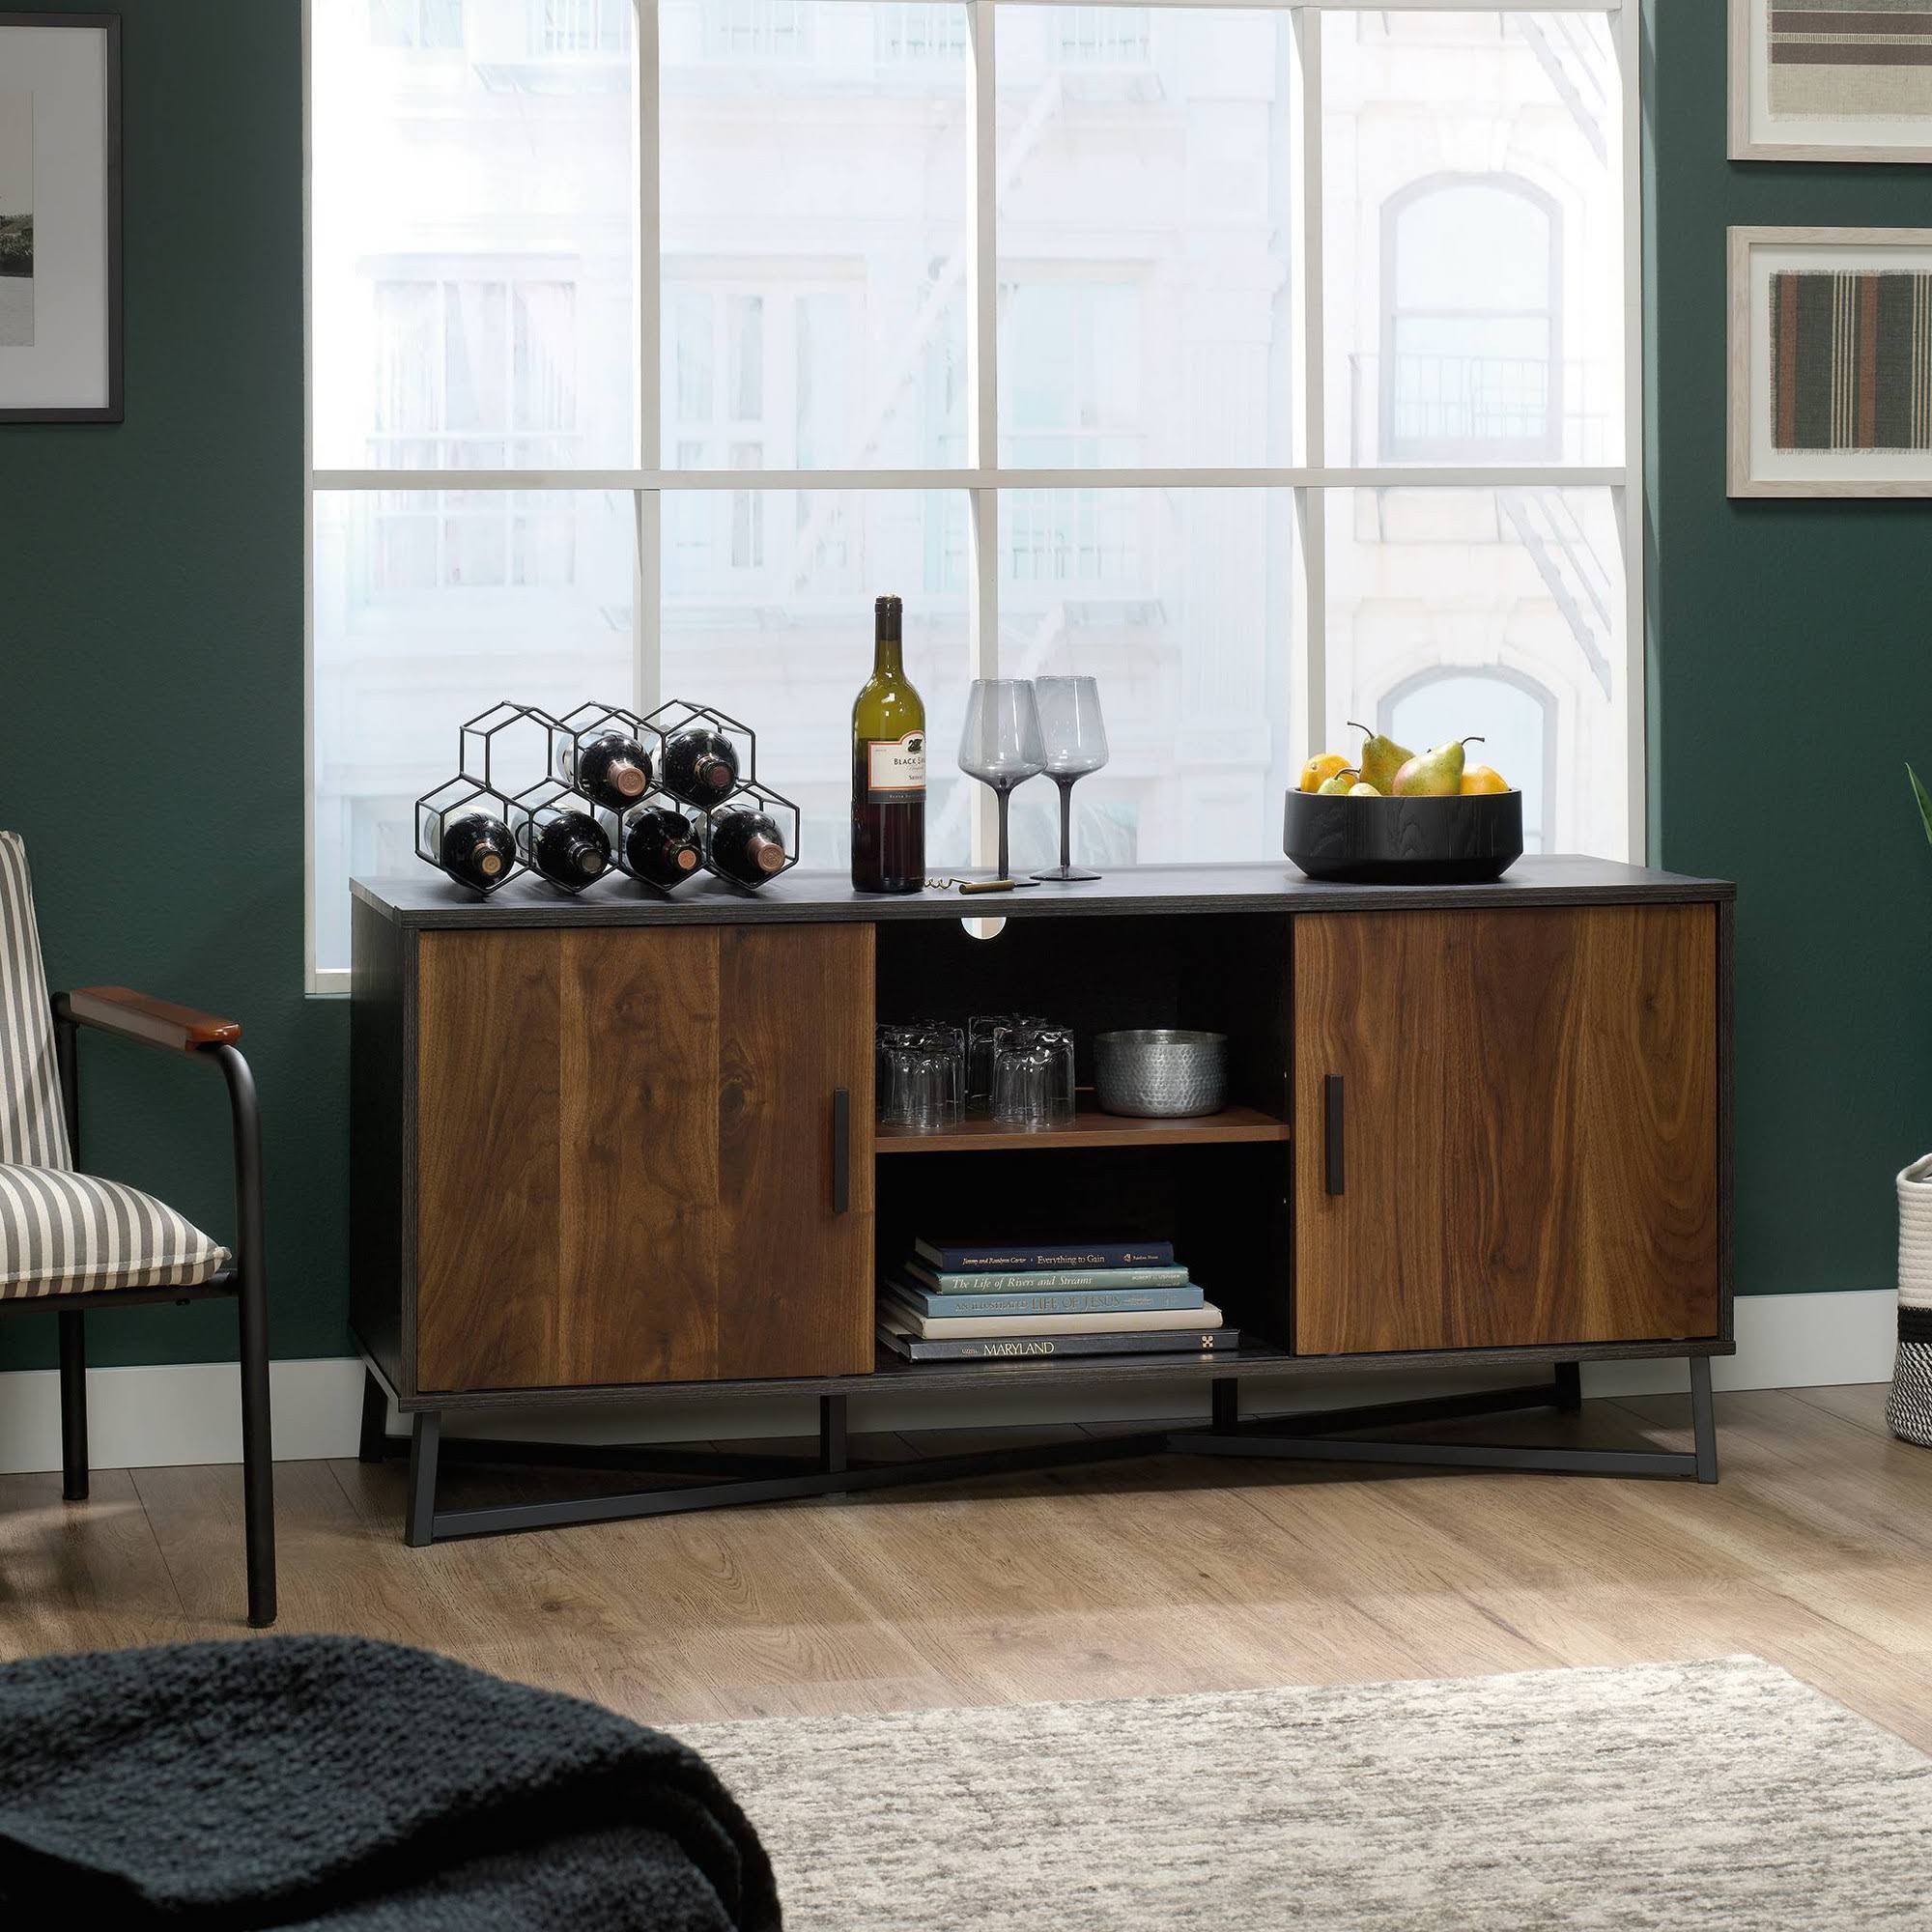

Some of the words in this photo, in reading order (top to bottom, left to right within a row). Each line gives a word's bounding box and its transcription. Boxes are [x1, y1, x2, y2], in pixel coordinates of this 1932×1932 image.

[894, 757, 917, 766] BLACK
[1037, 1255, 1076, 1265] Everything
[1087, 1254, 1105, 1264] Gain
[952, 1277, 970, 1289] The
[974, 1277, 990, 1291] Life
[994, 1276, 1005, 1291] of
[1007, 1276, 1035, 1288] Rivers
[1037, 1275, 1056, 1287] and
[1059, 1275, 1092, 1287] Streams
[955, 1302, 969, 1312] AN
[972, 1300, 1028, 1311] ILLUSTRATED
[1031, 1297, 1057, 1311] LIFE
[1062, 1296, 1080, 1309] OF
[1082, 1294, 1121, 1310] JESUS
[983, 1341, 1055, 1356] MARYLAND
